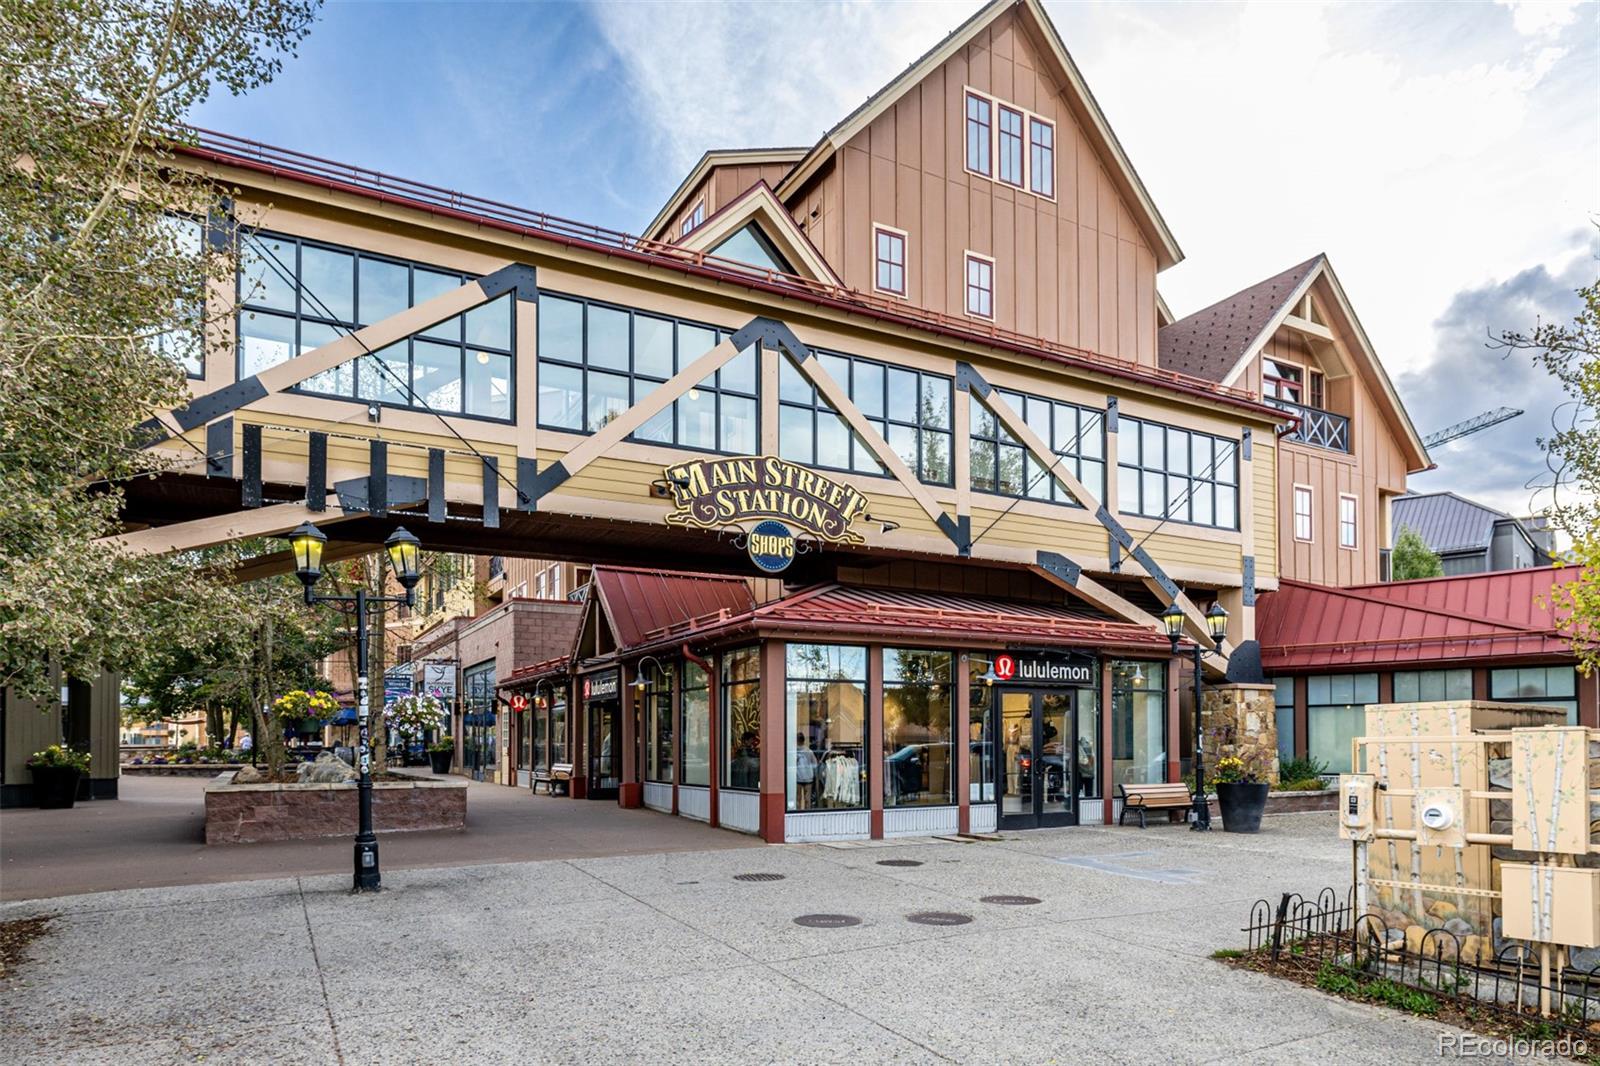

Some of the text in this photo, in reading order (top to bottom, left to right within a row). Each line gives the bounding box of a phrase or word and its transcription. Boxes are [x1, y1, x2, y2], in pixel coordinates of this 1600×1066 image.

[673, 458, 864, 522] MAIN STREET
[716, 488, 826, 527] STATION
[751, 533, 793, 557] SHOPS
[1019, 659, 1089, 680] lululemon
